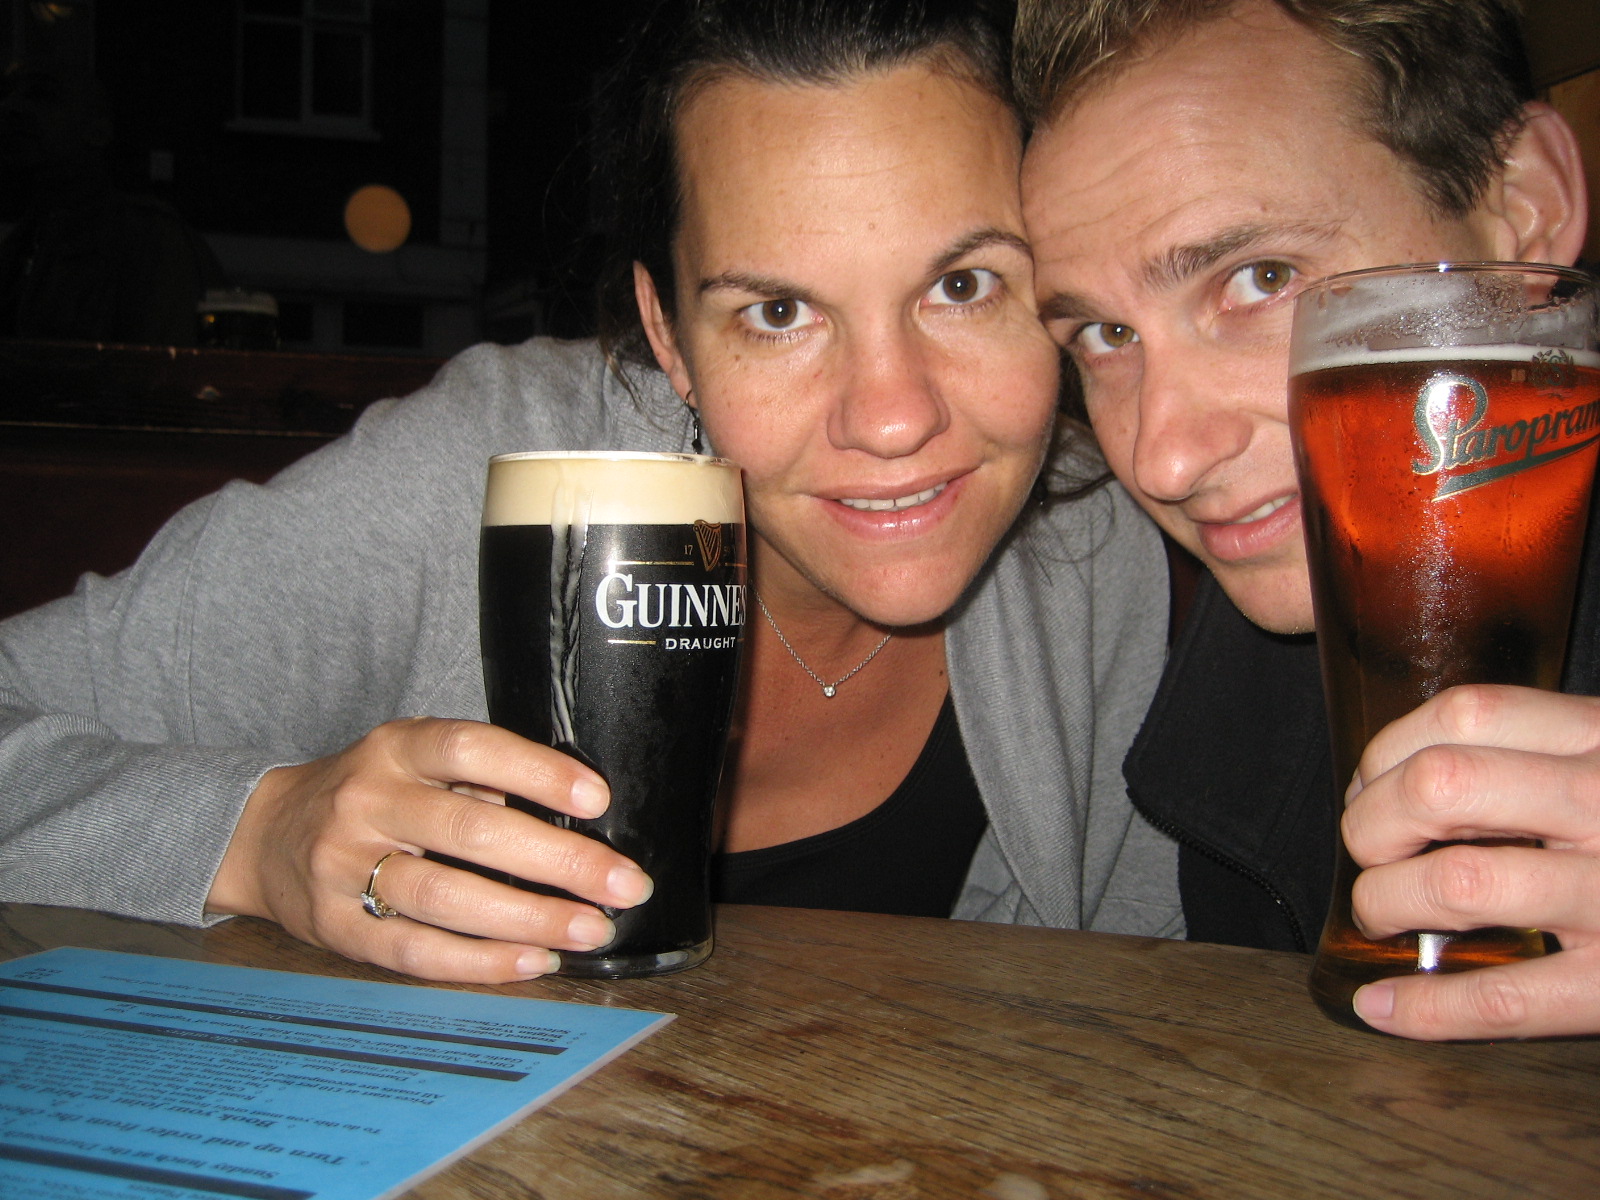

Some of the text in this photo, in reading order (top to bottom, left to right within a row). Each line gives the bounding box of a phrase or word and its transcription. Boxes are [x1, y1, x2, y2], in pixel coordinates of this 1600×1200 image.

[684, 545, 693, 555] 17
[665, 636, 735, 650] DRAUGHT
[516, 1025, 571, 1034] Selection
[518, 1030, 563, 1038] Belgian
[505, 1033, 556, 1042] Steamed
[159, 1050, 215, 1061] Yorkshire
[398, 1050, 461, 1061] Marinated
[485, 1054, 523, 1063] Garlic
[219, 1058, 278, 1069] forgetting
[339, 1062, 378, 1070] mixed
[474, 1059, 515, 1068] Olives
[144, 1073, 188, 1082] organic
[174, 1071, 212, 1079] recipe
[200, 1068, 262, 1080] depending
[273, 1072, 356, 1086] accompanied
[339, 1068, 408, 1081] Dartmouth
[193, 1080, 245, 1092] Chicken
[262, 1077, 296, 1085] head
[15, 1083, 38, 1091] in
[184, 1086, 217, 1094] lamb
[381, 1087, 421, 1095] roasts
[36, 1087, 82, 1098] bird
[168, 1091, 206, 1099] Roast
[217, 1091, 256, 1100] Roast
[110, 1096, 169, 1109] joint
[178, 1099, 211, 1108] from
[394, 1095, 434, 1105] Prices
[165, 1105, 218, 1117] your
[213, 1104, 249, 1113] order
[47, 1111, 82, 1122] the
[249, 1110, 283, 1118] must
[85, 1117, 138, 1131] from
[219, 1113, 275, 1127] Book
[313, 1119, 340, 1127] this
[142, 1126, 202, 1140] order
[201, 1136, 249, 1147] and
[102, 1146, 132, 1155] the
[253, 1143, 284, 1153] up
[154, 1154, 204, 1168] lunch
[289, 1149, 344, 1165] Turn
[212, 1163, 273, 1179] Sunday
